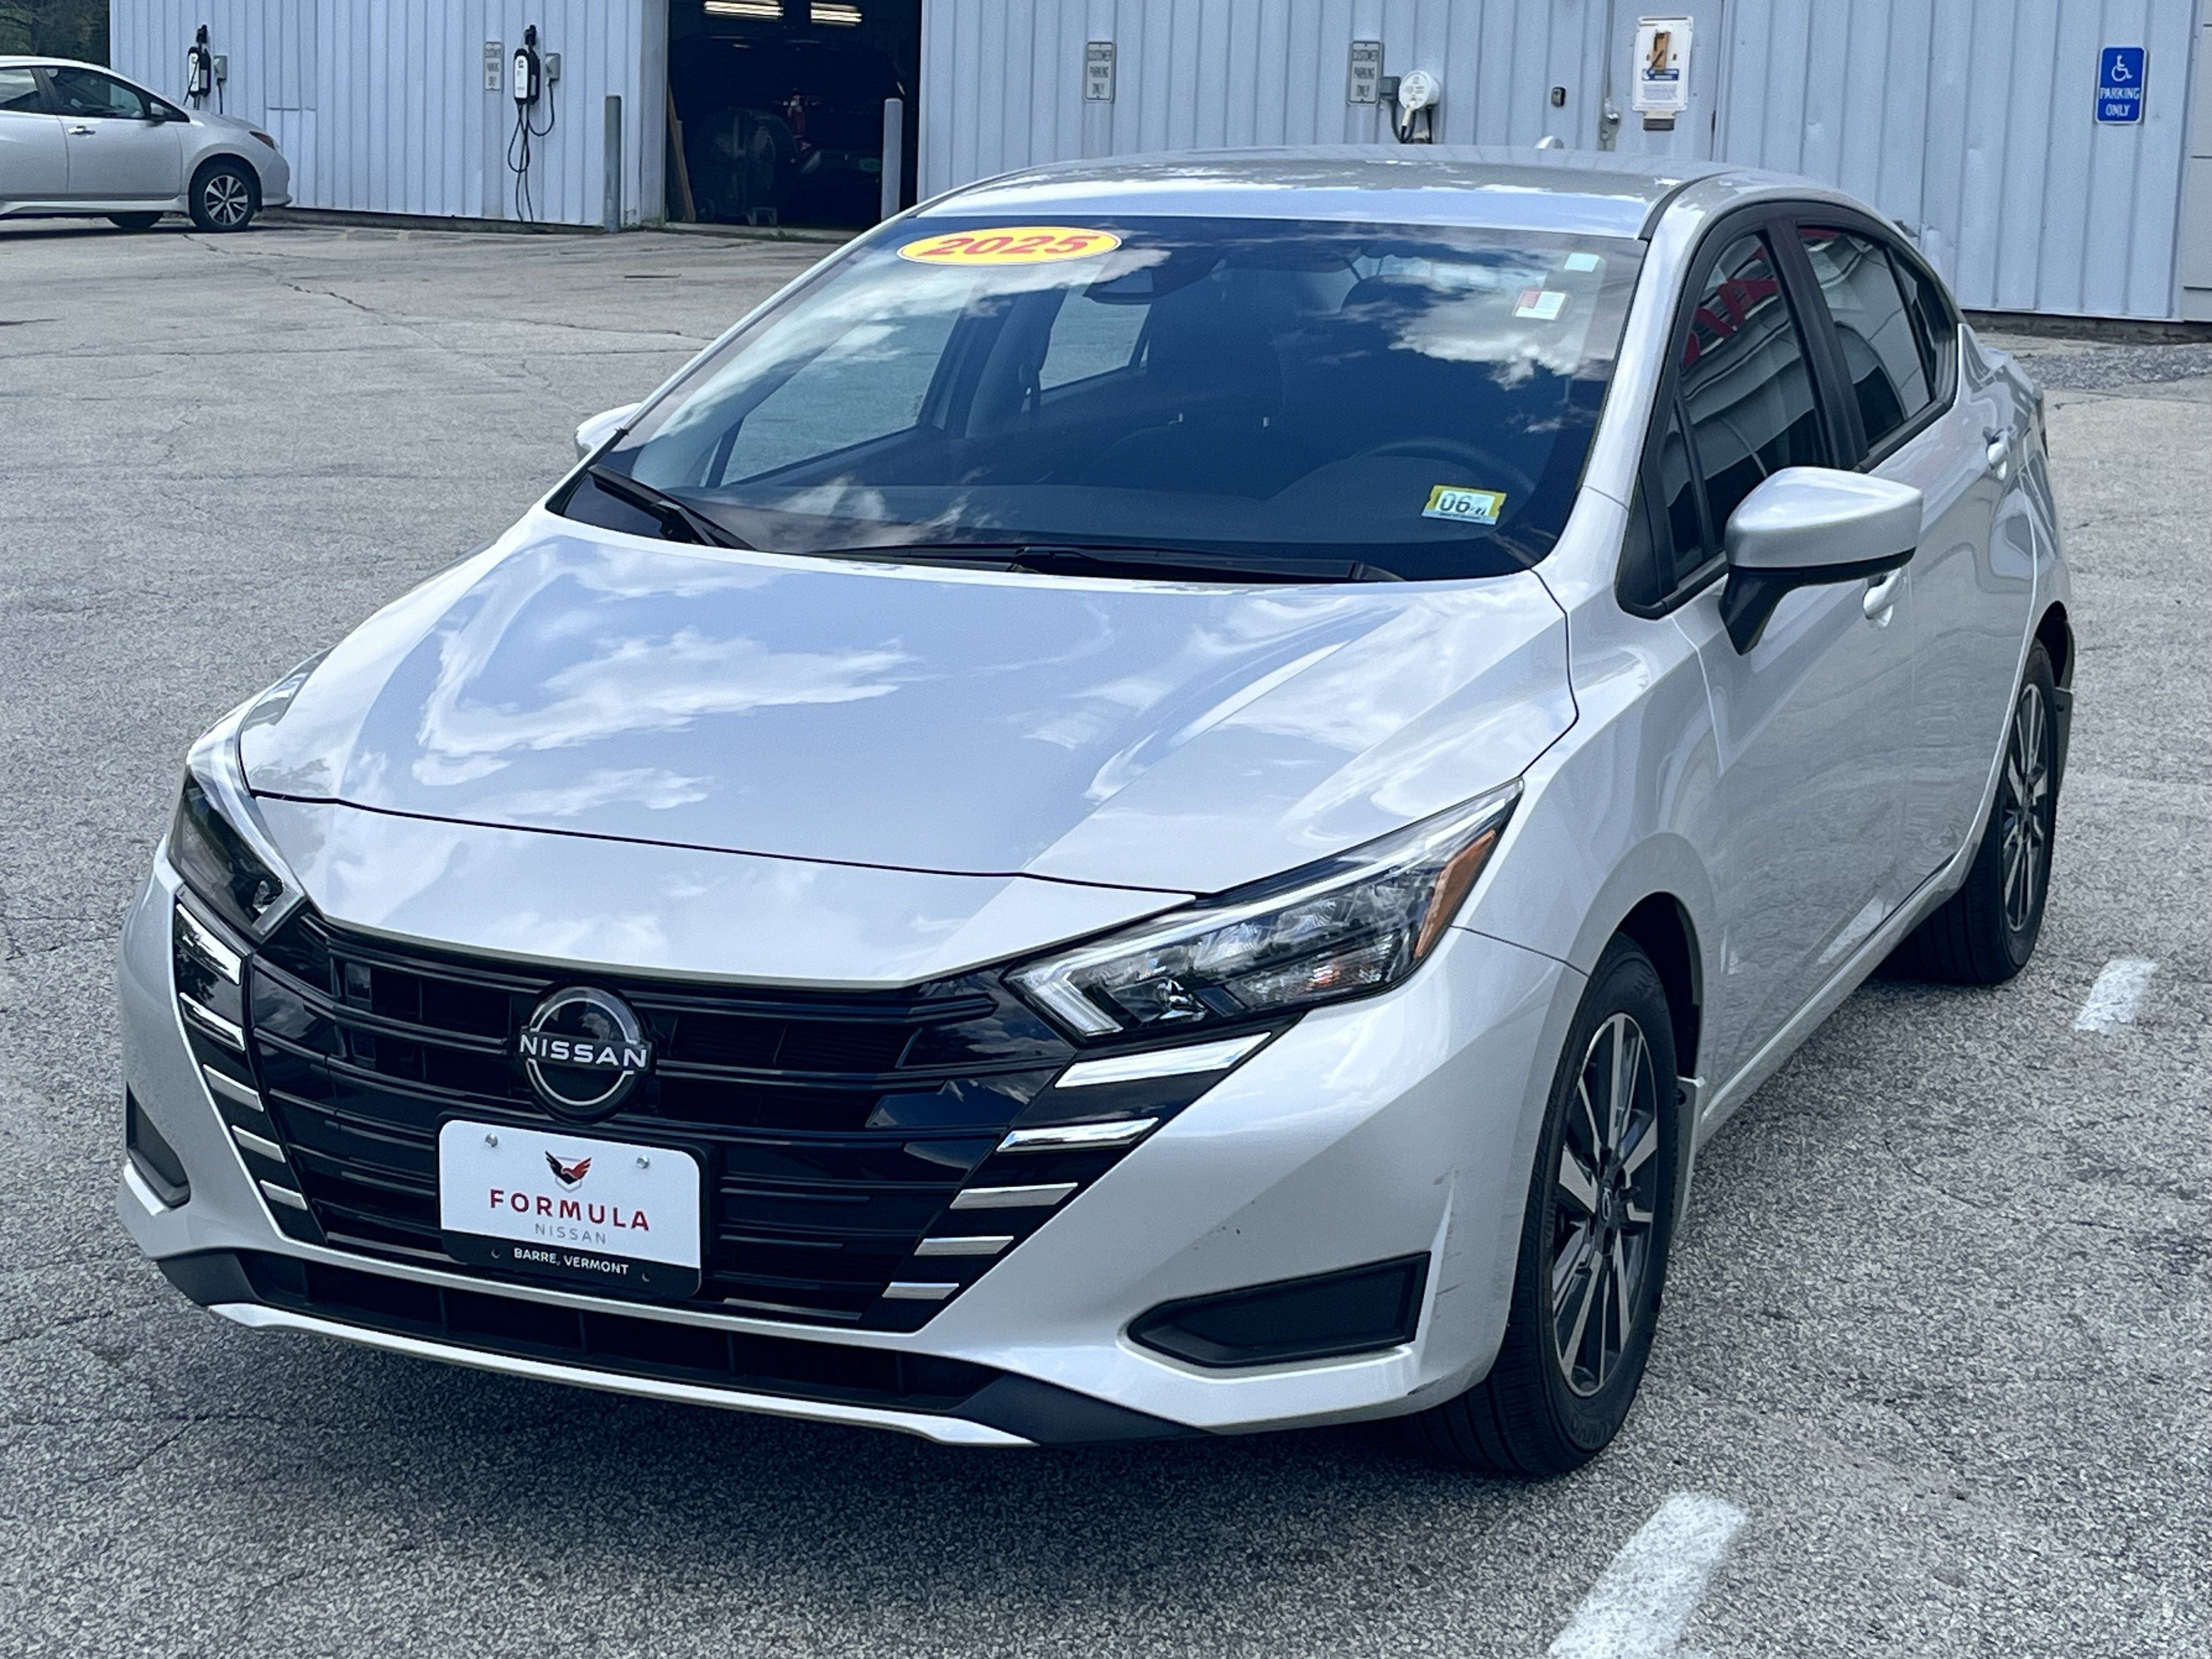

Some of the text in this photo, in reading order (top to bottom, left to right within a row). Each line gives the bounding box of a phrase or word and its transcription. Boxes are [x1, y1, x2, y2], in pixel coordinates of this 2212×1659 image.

[2099, 87, 2140, 100] PARKING
[2105, 103, 2131, 117] ONLY
[916, 235, 1102, 257] 2025
[1440, 493, 1474, 512] 06
[520, 1034, 647, 1068] NISSAN
[490, 1189, 649, 1231] FORMULA
[535, 1223, 606, 1244] NISSAN
[514, 1248, 629, 1276] BARRE, VERMONT
